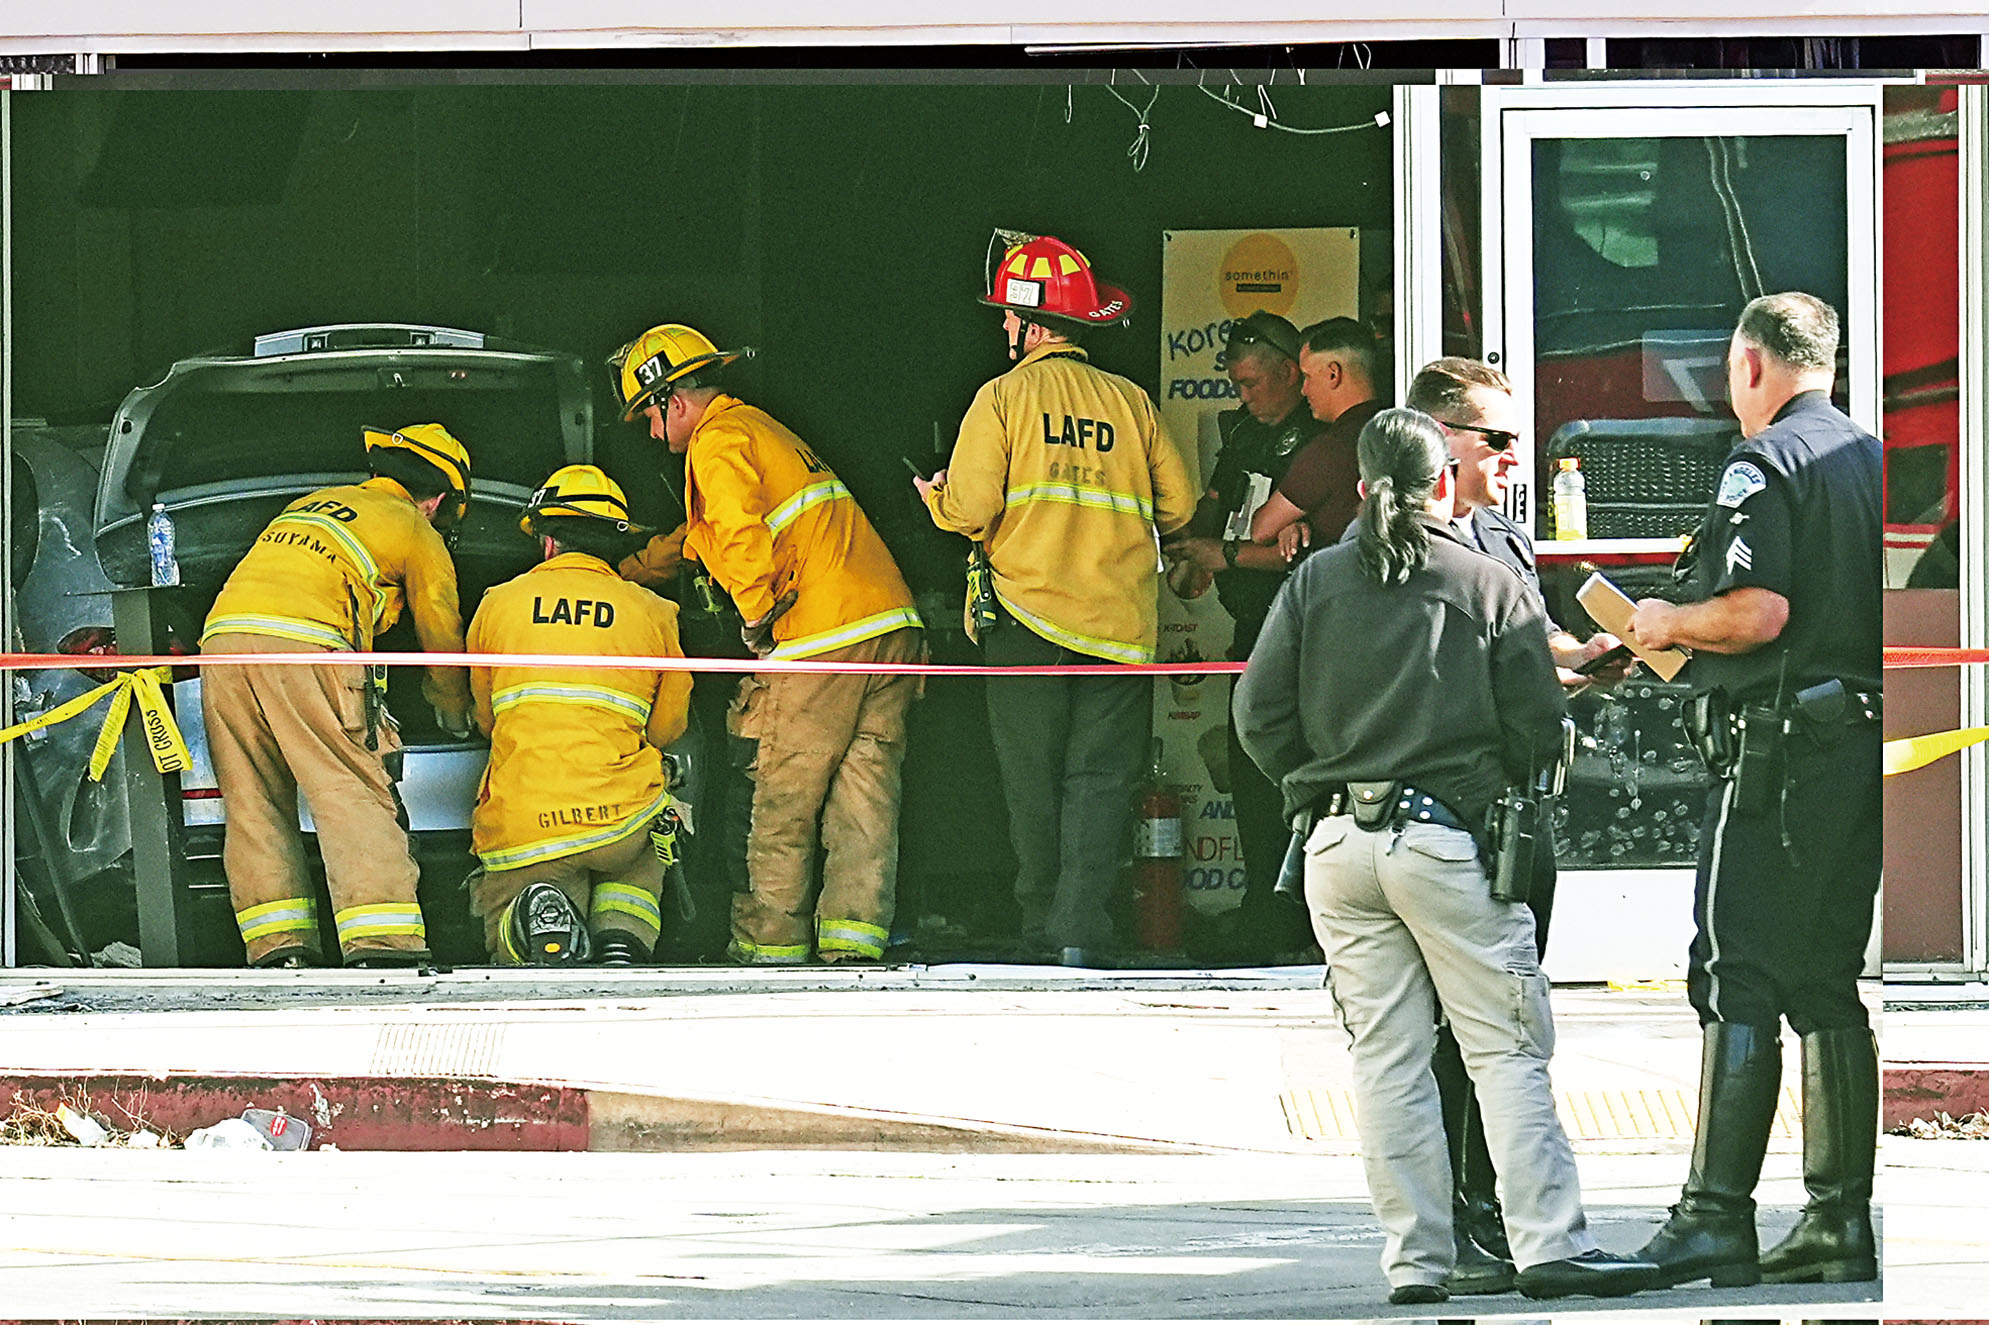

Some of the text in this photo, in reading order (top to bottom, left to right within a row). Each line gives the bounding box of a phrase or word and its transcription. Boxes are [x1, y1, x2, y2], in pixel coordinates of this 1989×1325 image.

[1010, 281, 1034, 305] 37
[1088, 300, 1123, 318] GATES
[1167, 318, 1243, 361] Kore
[638, 356, 663, 385] 37
[1043, 413, 1115, 453] LAFD
[1049, 461, 1106, 485] GATES
[527, 488, 547, 508] 37
[284, 500, 359, 523] AFD
[261, 531, 337, 565] SUYAMA
[532, 596, 615, 628] LAFD
[158, 752, 184, 772] OT
[538, 803, 622, 829] GILBERT
